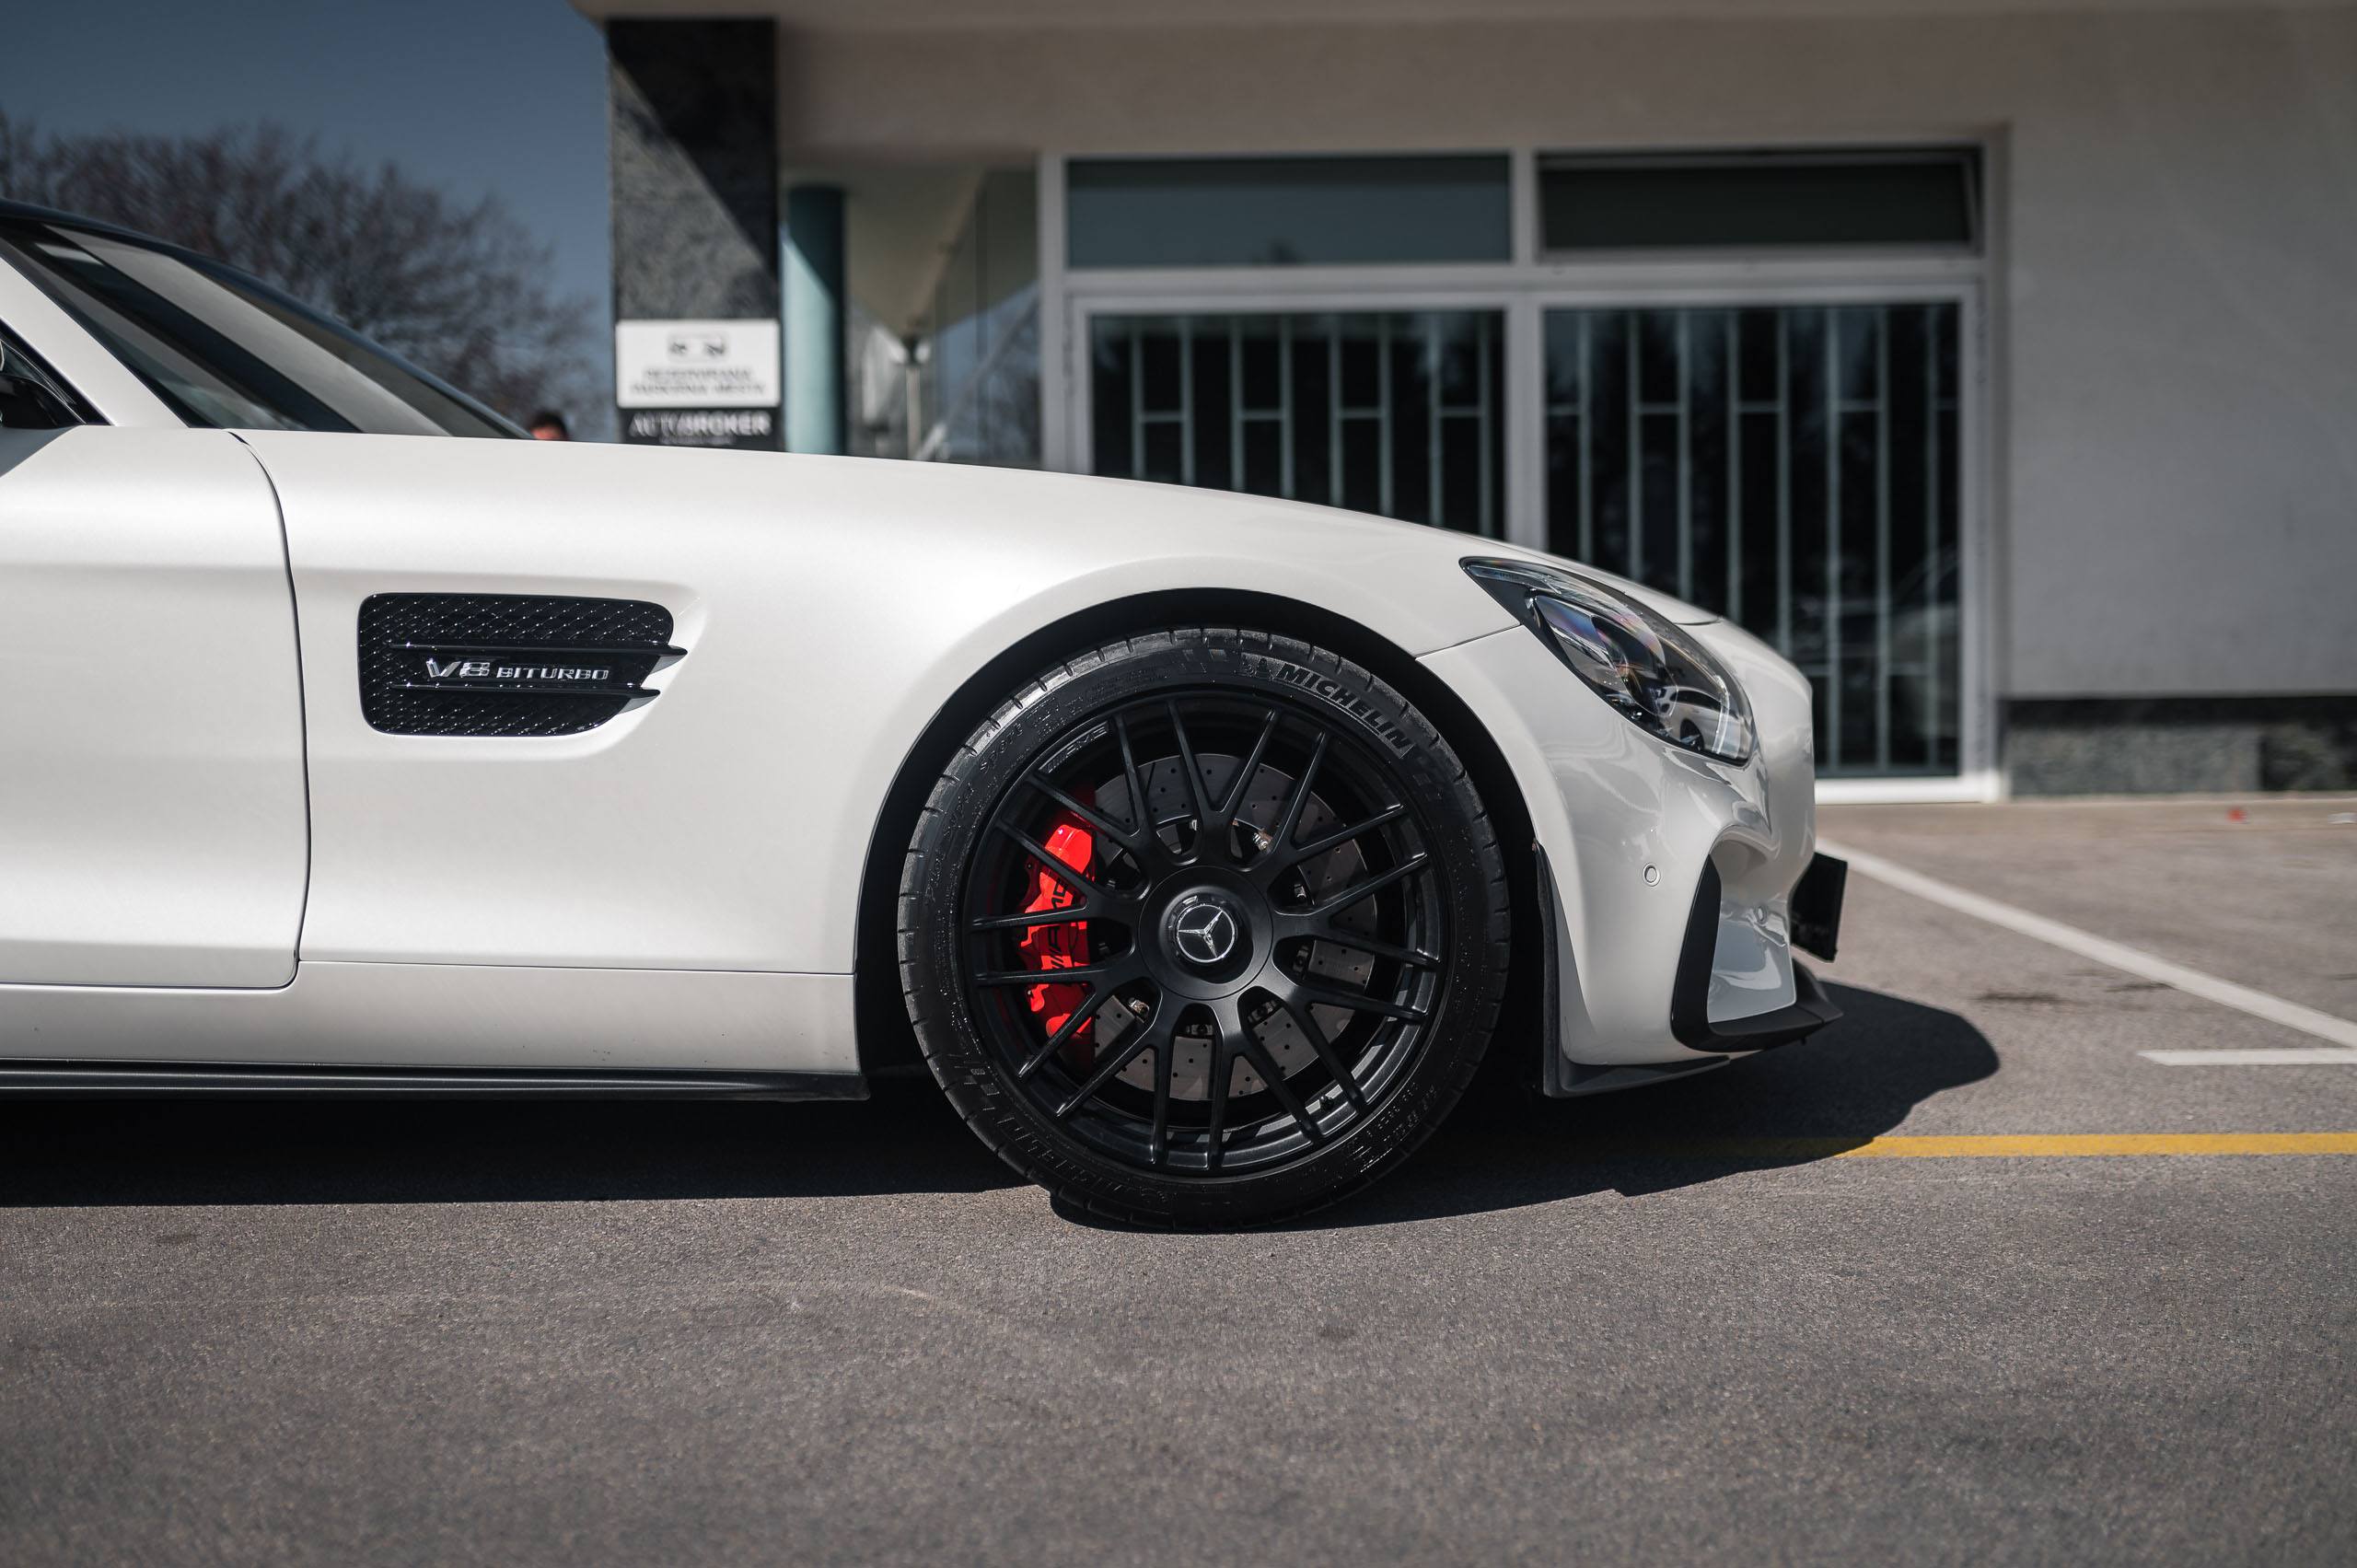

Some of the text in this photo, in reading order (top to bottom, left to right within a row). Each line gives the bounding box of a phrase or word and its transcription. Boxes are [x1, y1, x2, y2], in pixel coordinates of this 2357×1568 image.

[425, 657, 609, 679] V8 BITURBO
[1276, 662, 1413, 750] MICHELIN
